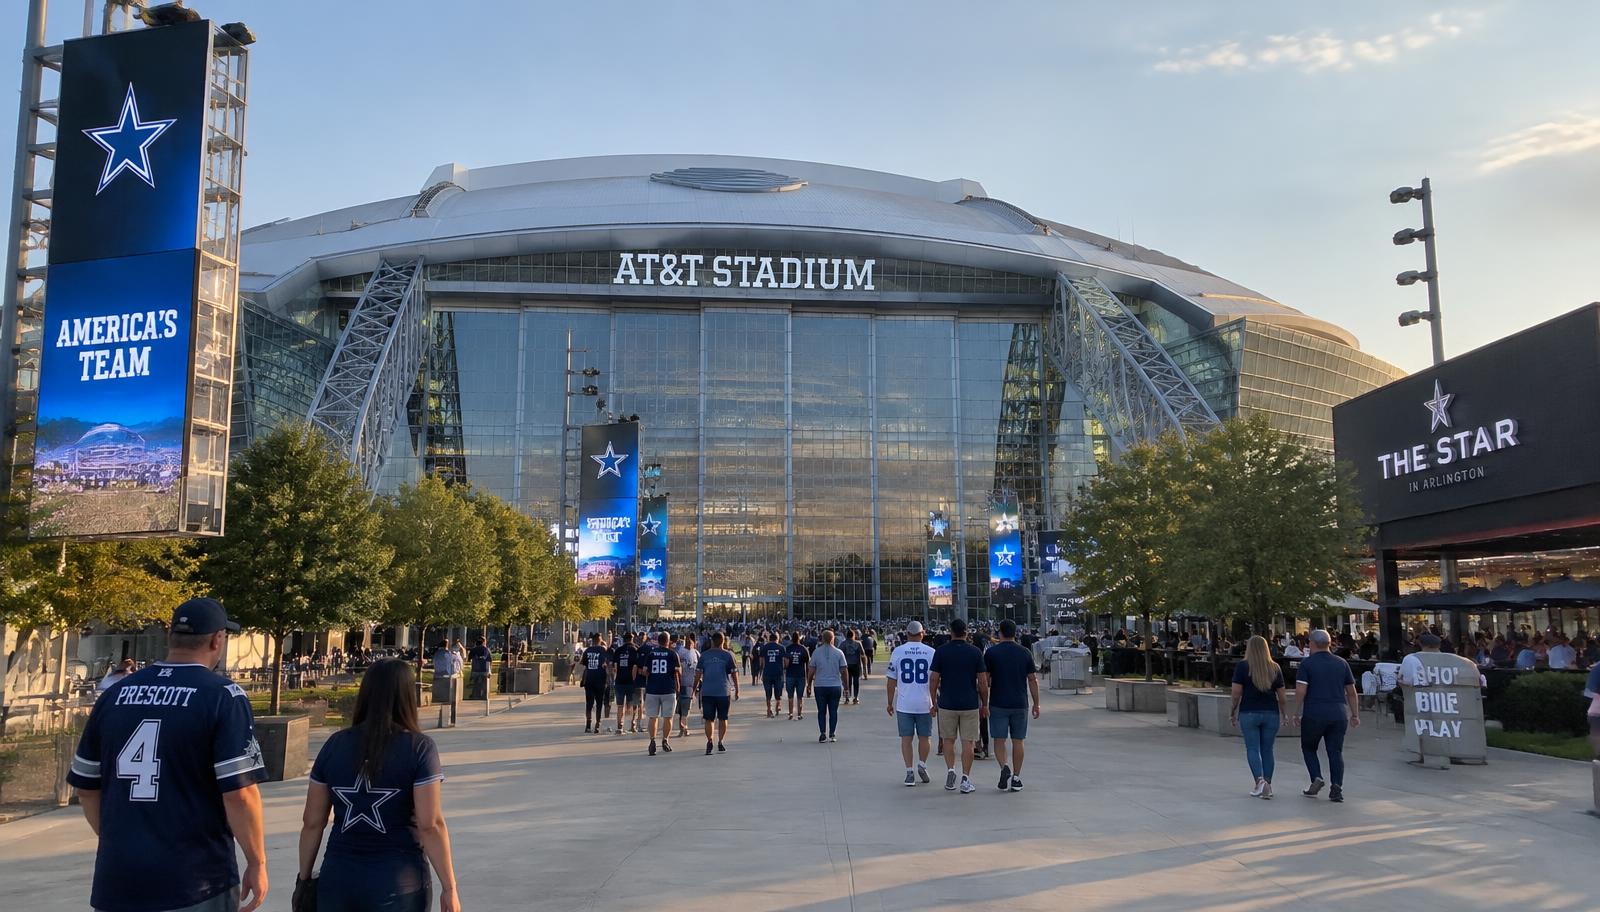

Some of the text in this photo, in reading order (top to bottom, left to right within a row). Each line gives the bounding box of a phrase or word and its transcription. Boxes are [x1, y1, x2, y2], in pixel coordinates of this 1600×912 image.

[613, 253, 876, 291] AT&T STADIUM
[56, 309, 178, 347] AMERICA'S
[79, 346, 152, 381] TEAM
[1377, 418, 1518, 479] THE STAR
[1409, 466, 1485, 493] IN ARLINGTON
[900, 658, 928, 683] 88
[115, 685, 197, 707] PRESCOTT
[116, 719, 161, 801] 4
